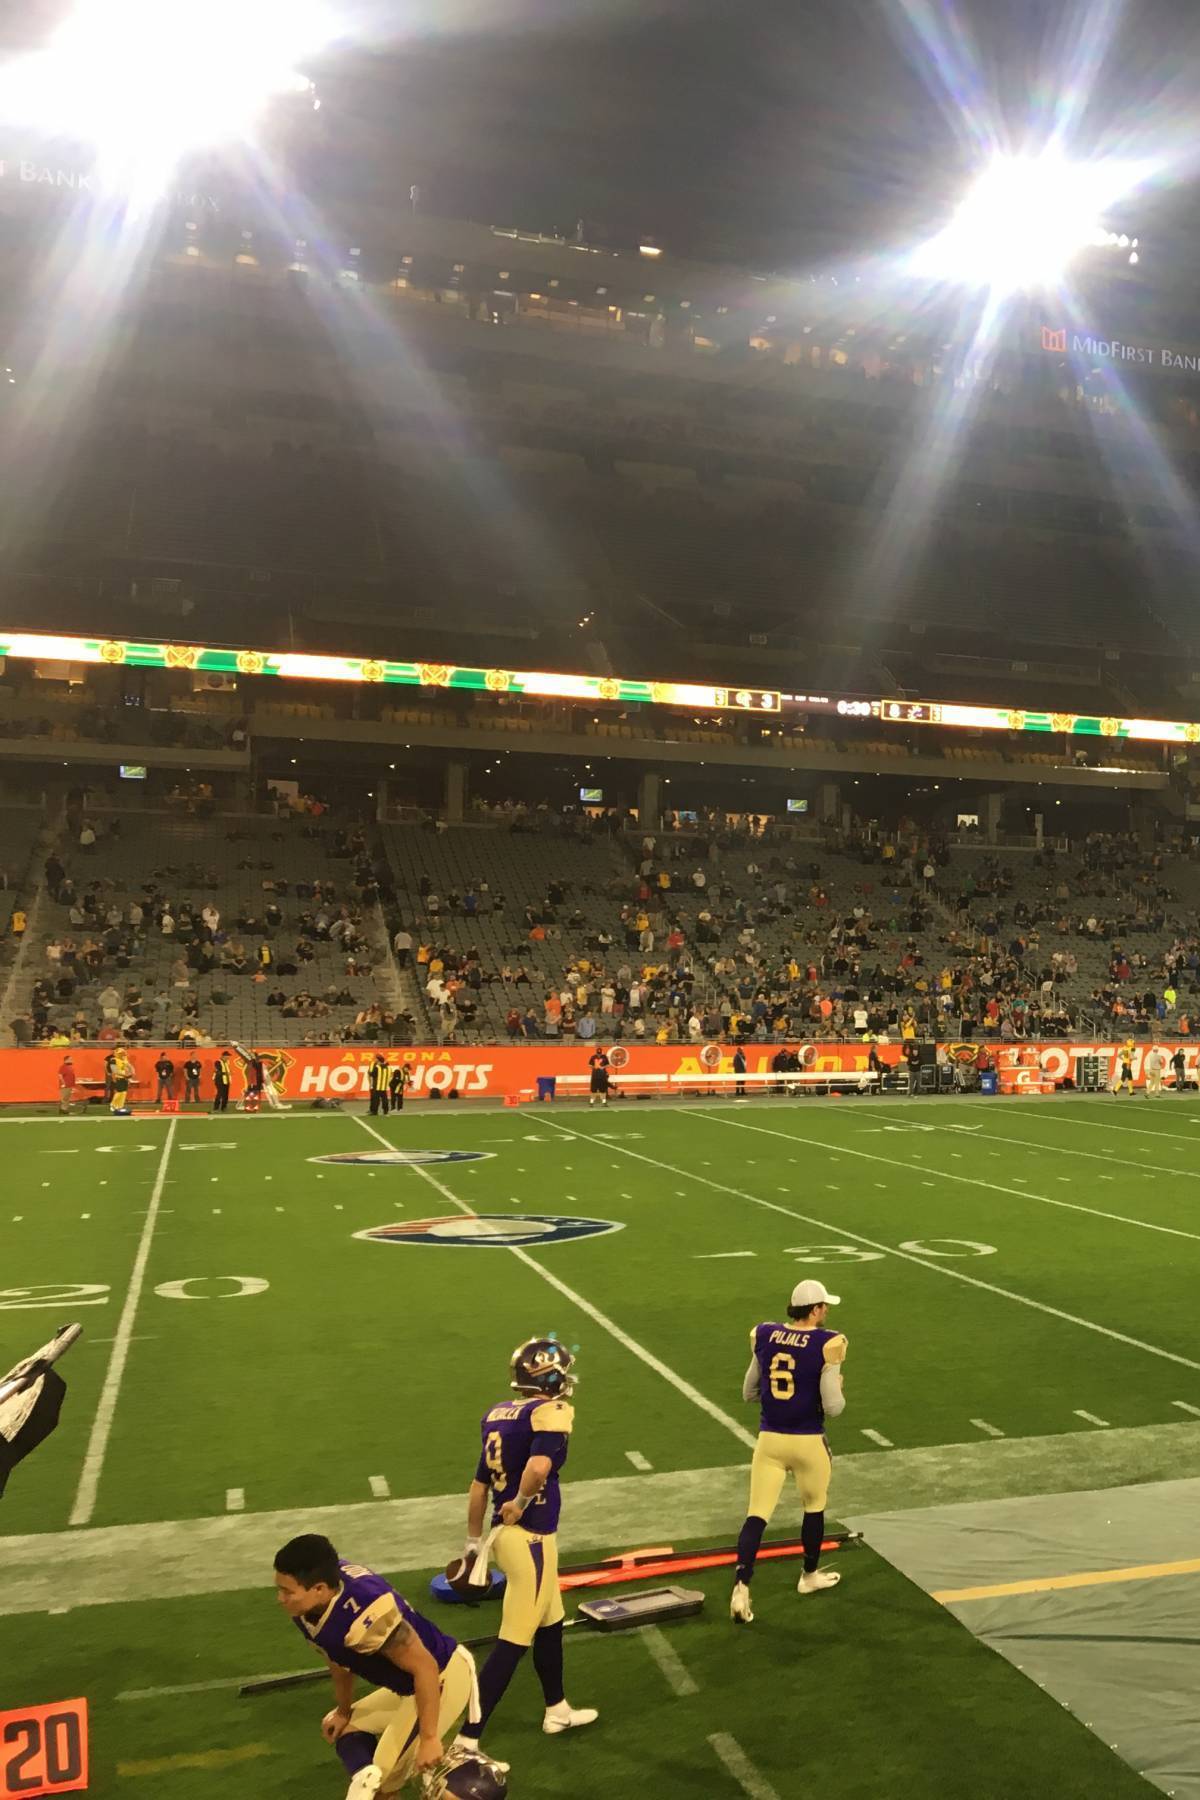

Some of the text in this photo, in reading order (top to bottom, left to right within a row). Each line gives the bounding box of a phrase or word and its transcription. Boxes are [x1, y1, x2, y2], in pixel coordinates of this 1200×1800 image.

[341, 1051, 453, 1062] ARIZONA
[300, 1063, 494, 1092] HOTHOTS
[768, 1330, 810, 1348] PUJALS
[769, 1352, 796, 1401] 6
[342, 1597, 361, 1614] 7
[3, 1711, 82, 1793] 20
